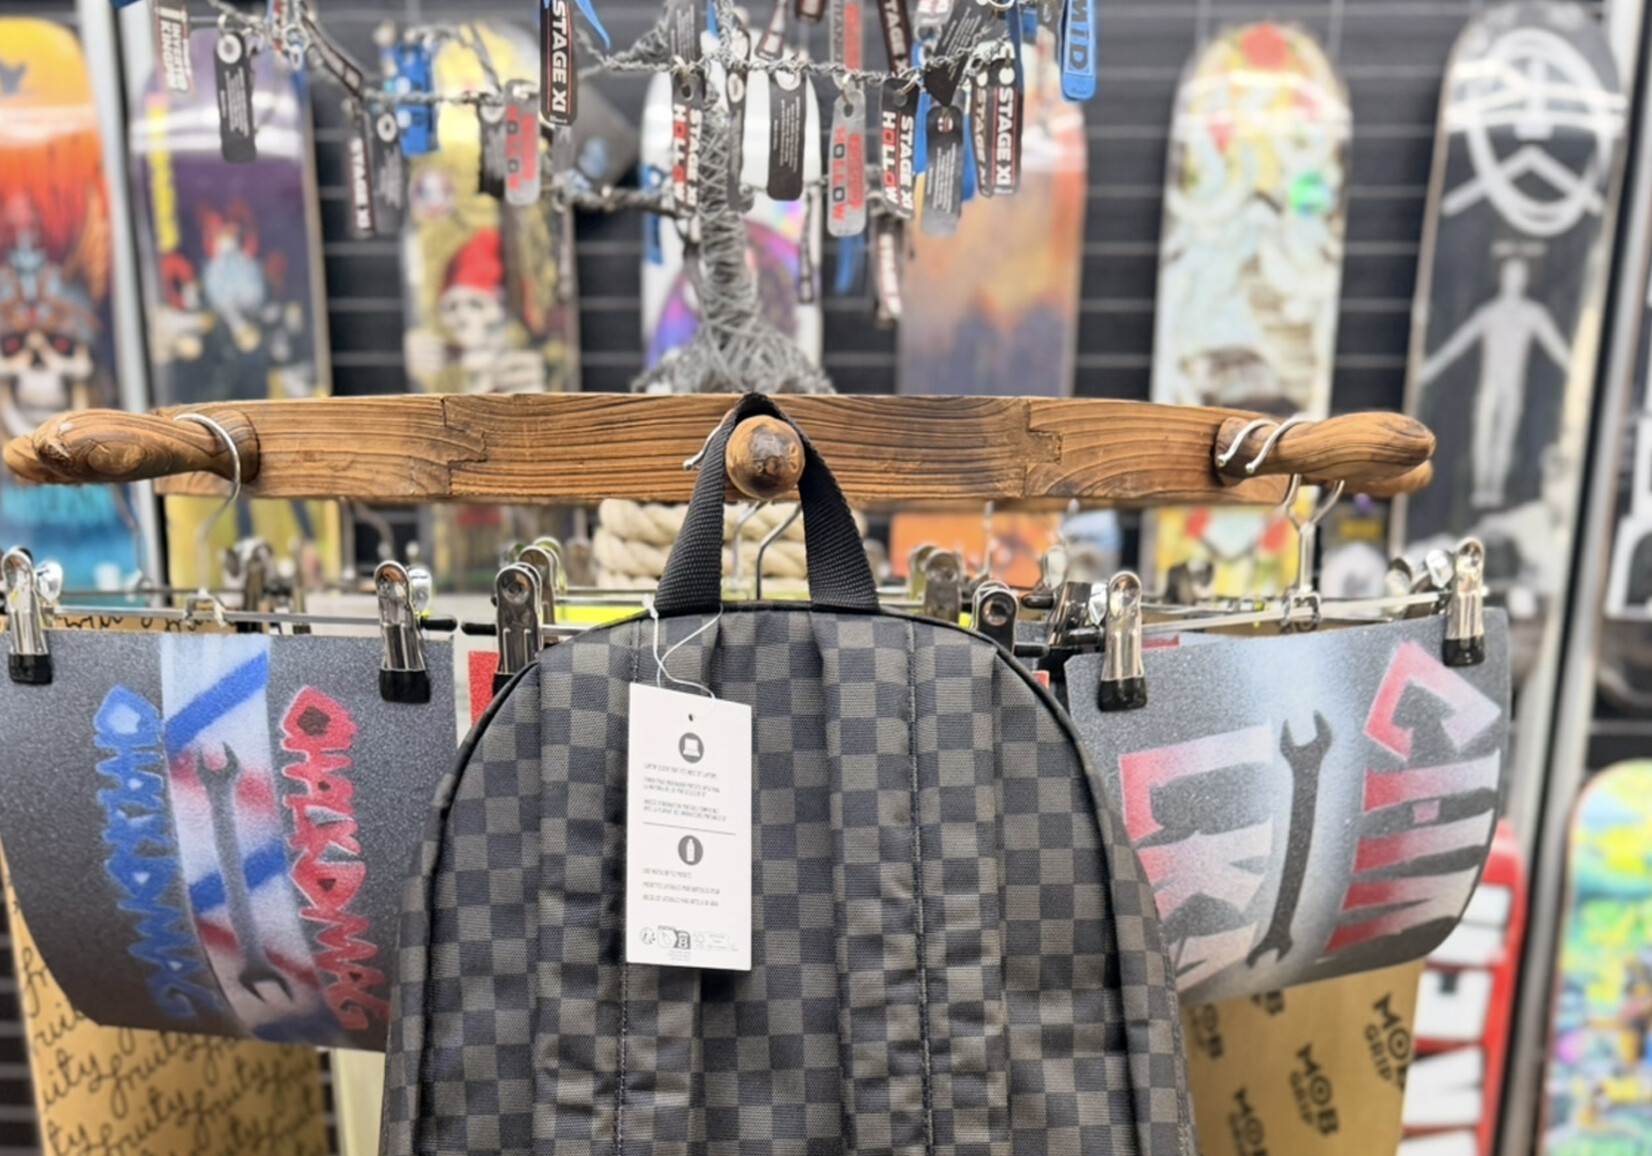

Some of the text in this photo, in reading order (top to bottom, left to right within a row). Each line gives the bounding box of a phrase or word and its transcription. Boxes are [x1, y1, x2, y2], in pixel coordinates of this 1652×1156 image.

[552, 0, 567, 112] STAGE XI
[884, 0, 906, 55] TAGE
[688, 108, 702, 181] STAGE
[882, 111, 898, 204] HOLLOW
[899, 115, 914, 210] STAGE XI
[974, 87, 987, 162] STAGE
[995, 87, 1014, 185] STAGE XI
[832, 127, 847, 221] HOLLOW
[1295, 1043, 1340, 1136] MOB
